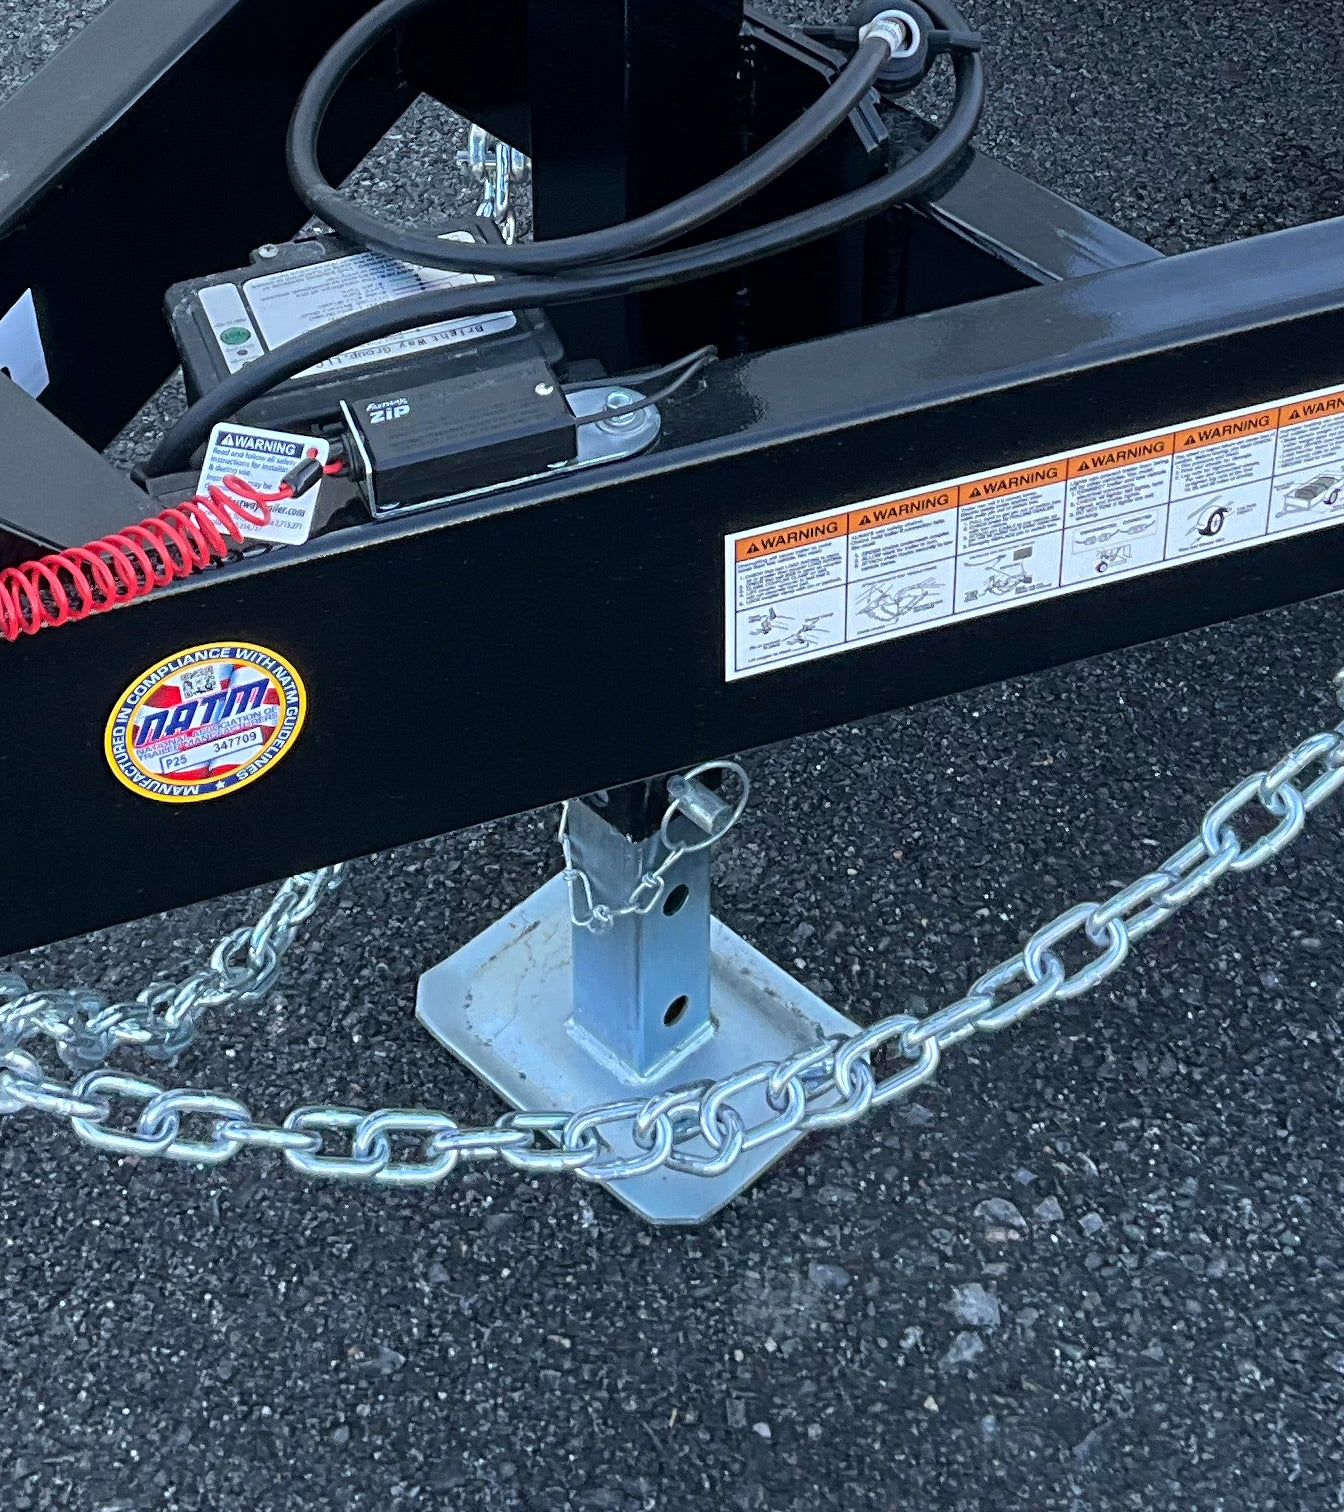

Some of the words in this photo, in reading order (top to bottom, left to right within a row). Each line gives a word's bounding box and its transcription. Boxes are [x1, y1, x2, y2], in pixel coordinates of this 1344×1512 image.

[433, 324, 484, 342] Bright
[1198, 413, 1269, 442] WARNING
[213, 447, 230, 455] Read
[235, 434, 296, 456] WARNING
[1091, 439, 1164, 468] WARNING
[983, 465, 1057, 495] WARNING
[873, 492, 948, 522] WARNING
[761, 520, 838, 550] WARNING
[235, 648, 277, 670] WITH
[126, 647, 231, 705] COMPLIANCE
[272, 666, 300, 705] NATM
[115, 709, 131, 725] IN
[135, 734, 191, 755] NATIONAL
[193, 713, 262, 740] ASSOCIATION
[263, 705, 278, 716] OF
[165, 755, 188, 770] P25
[213, 731, 258, 754] 347709
[236, 705, 299, 781] GUIDELINES
[112, 726, 200, 796] MANUFACTURED
